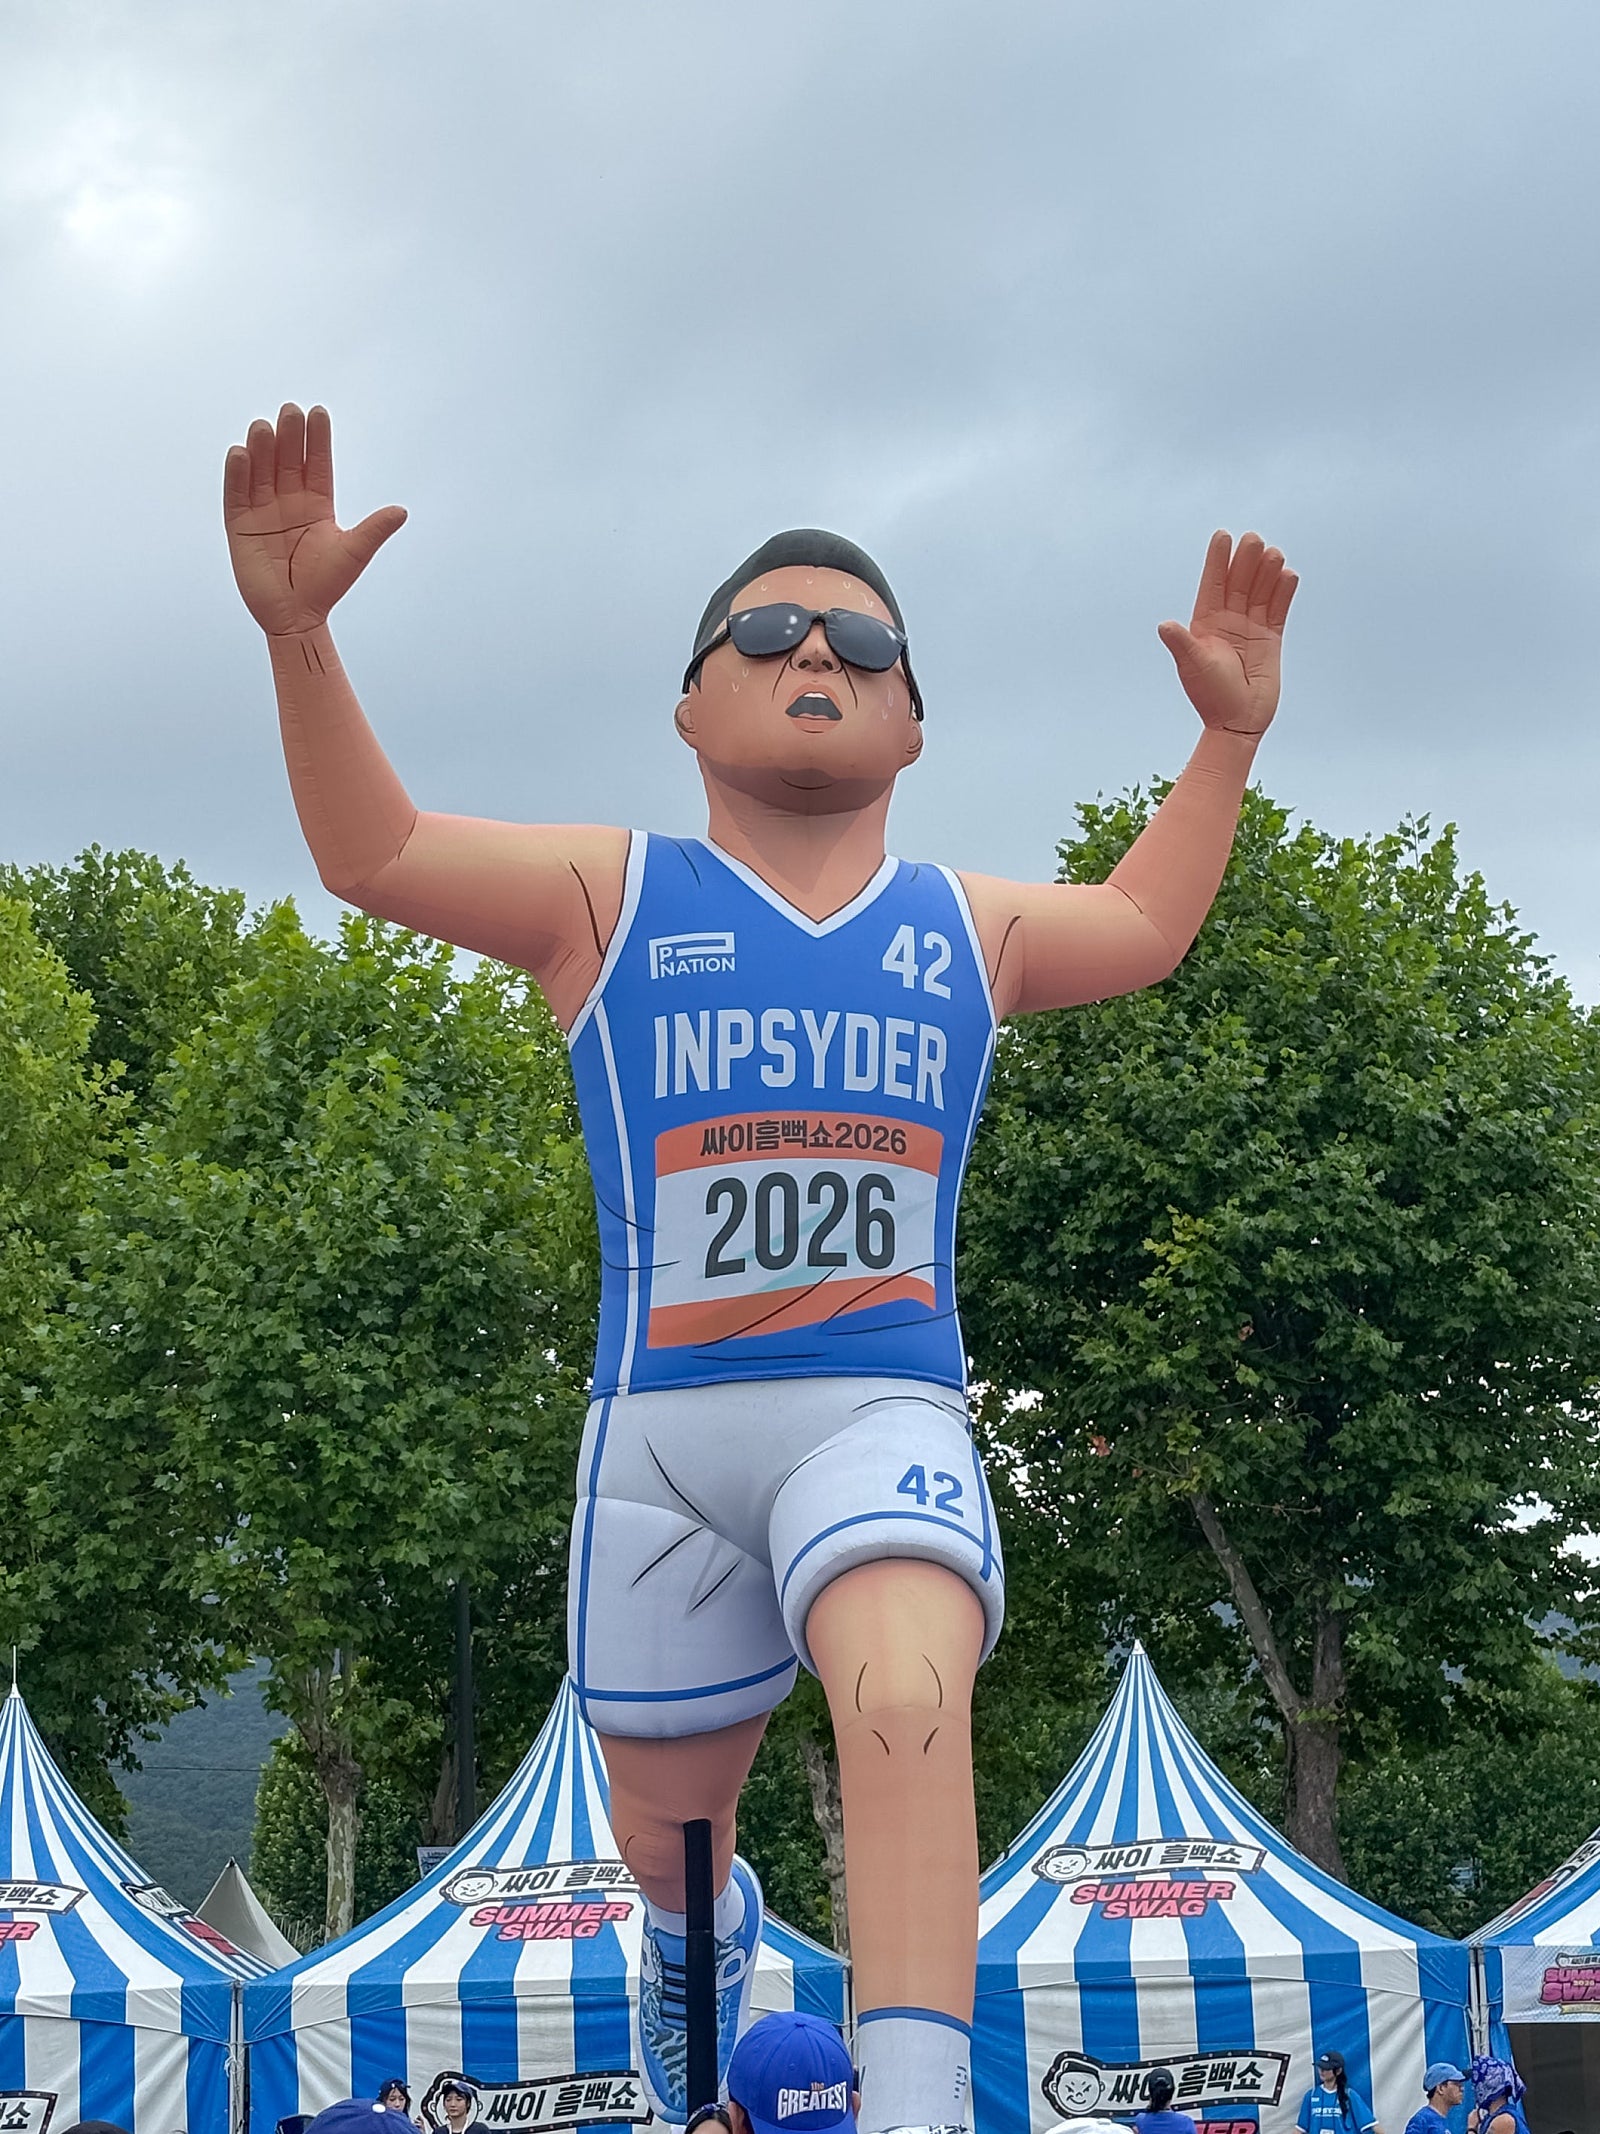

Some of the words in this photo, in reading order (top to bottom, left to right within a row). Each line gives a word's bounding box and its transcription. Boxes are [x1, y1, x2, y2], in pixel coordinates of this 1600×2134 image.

[658, 956, 736, 979] NATION
[881, 923, 952, 1001] 42
[653, 1007, 948, 1112] INPSYDER
[704, 1170, 896, 1280] 2026
[896, 1463, 964, 1518] 42
[1094, 1846, 1154, 1871] 싸이
[1159, 1843, 1242, 1865] 흠뻑쇼
[499, 1868, 561, 1894] 싸이
[1071, 1882, 1234, 1904] SUMMER
[471, 1902, 633, 1927] SUMMER
[1101, 1900, 1207, 1919] SWAG
[497, 1920, 601, 1941] SWAG
[1176, 2060, 1264, 2099] 흠뻑쇼
[485, 2089, 547, 2123] 싸이
[552, 2080, 639, 2118] 흠뻑쇼
[777, 2081, 847, 2121] GREATEST
